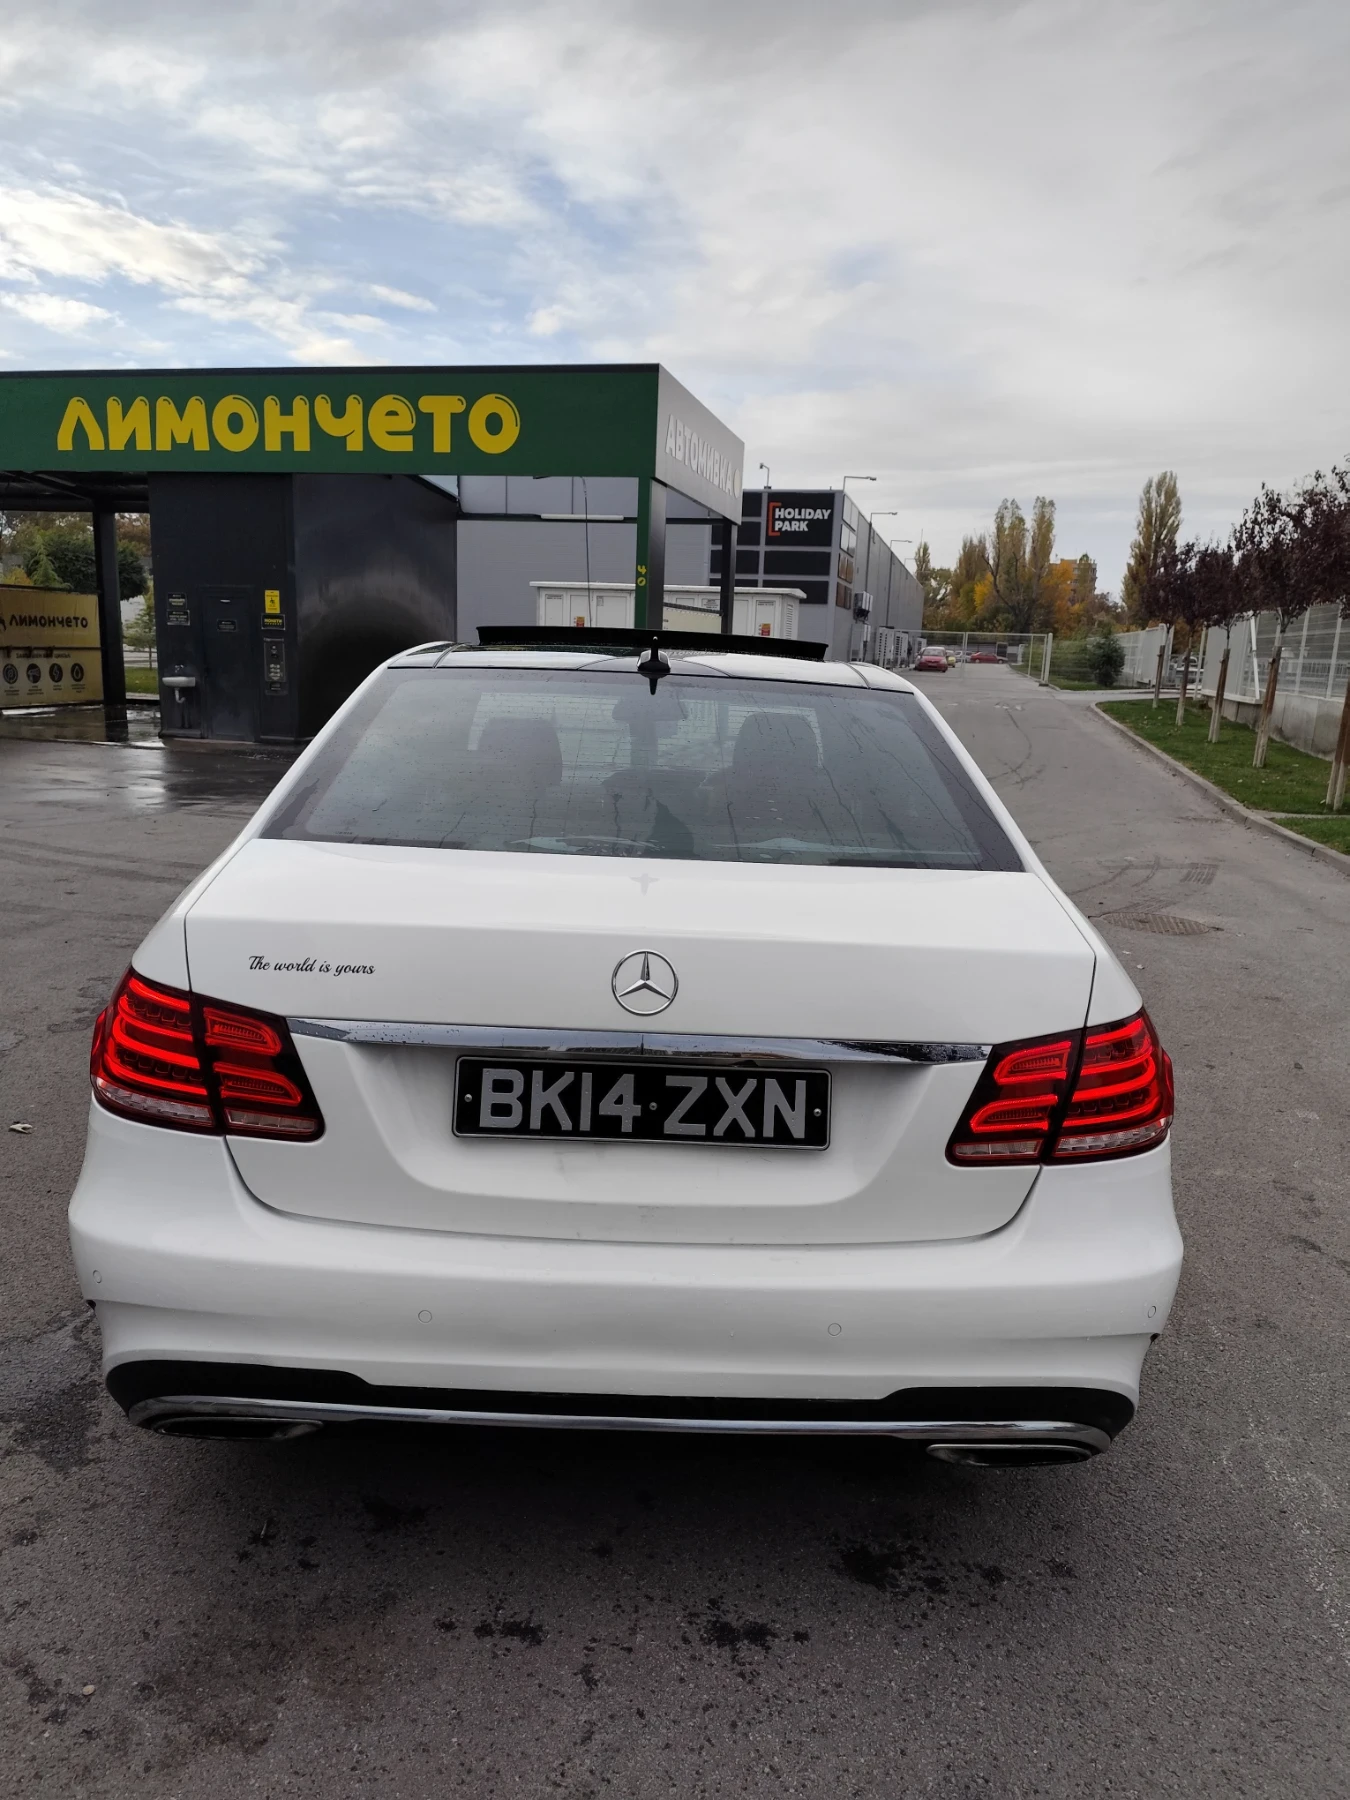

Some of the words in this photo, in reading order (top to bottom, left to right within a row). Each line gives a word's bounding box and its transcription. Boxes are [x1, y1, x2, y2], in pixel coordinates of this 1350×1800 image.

[665, 413, 734, 497] АВТОМИВКА
[774, 507, 832, 520] HOLIDAY
[774, 520, 809, 531] PARK
[248, 955, 271, 971] The
[273, 957, 318, 973] world
[318, 960, 332, 973] is
[333, 964, 376, 977] yours
[479, 1067, 642, 1133] BK14
[663, 1074, 807, 1139] ZXN
